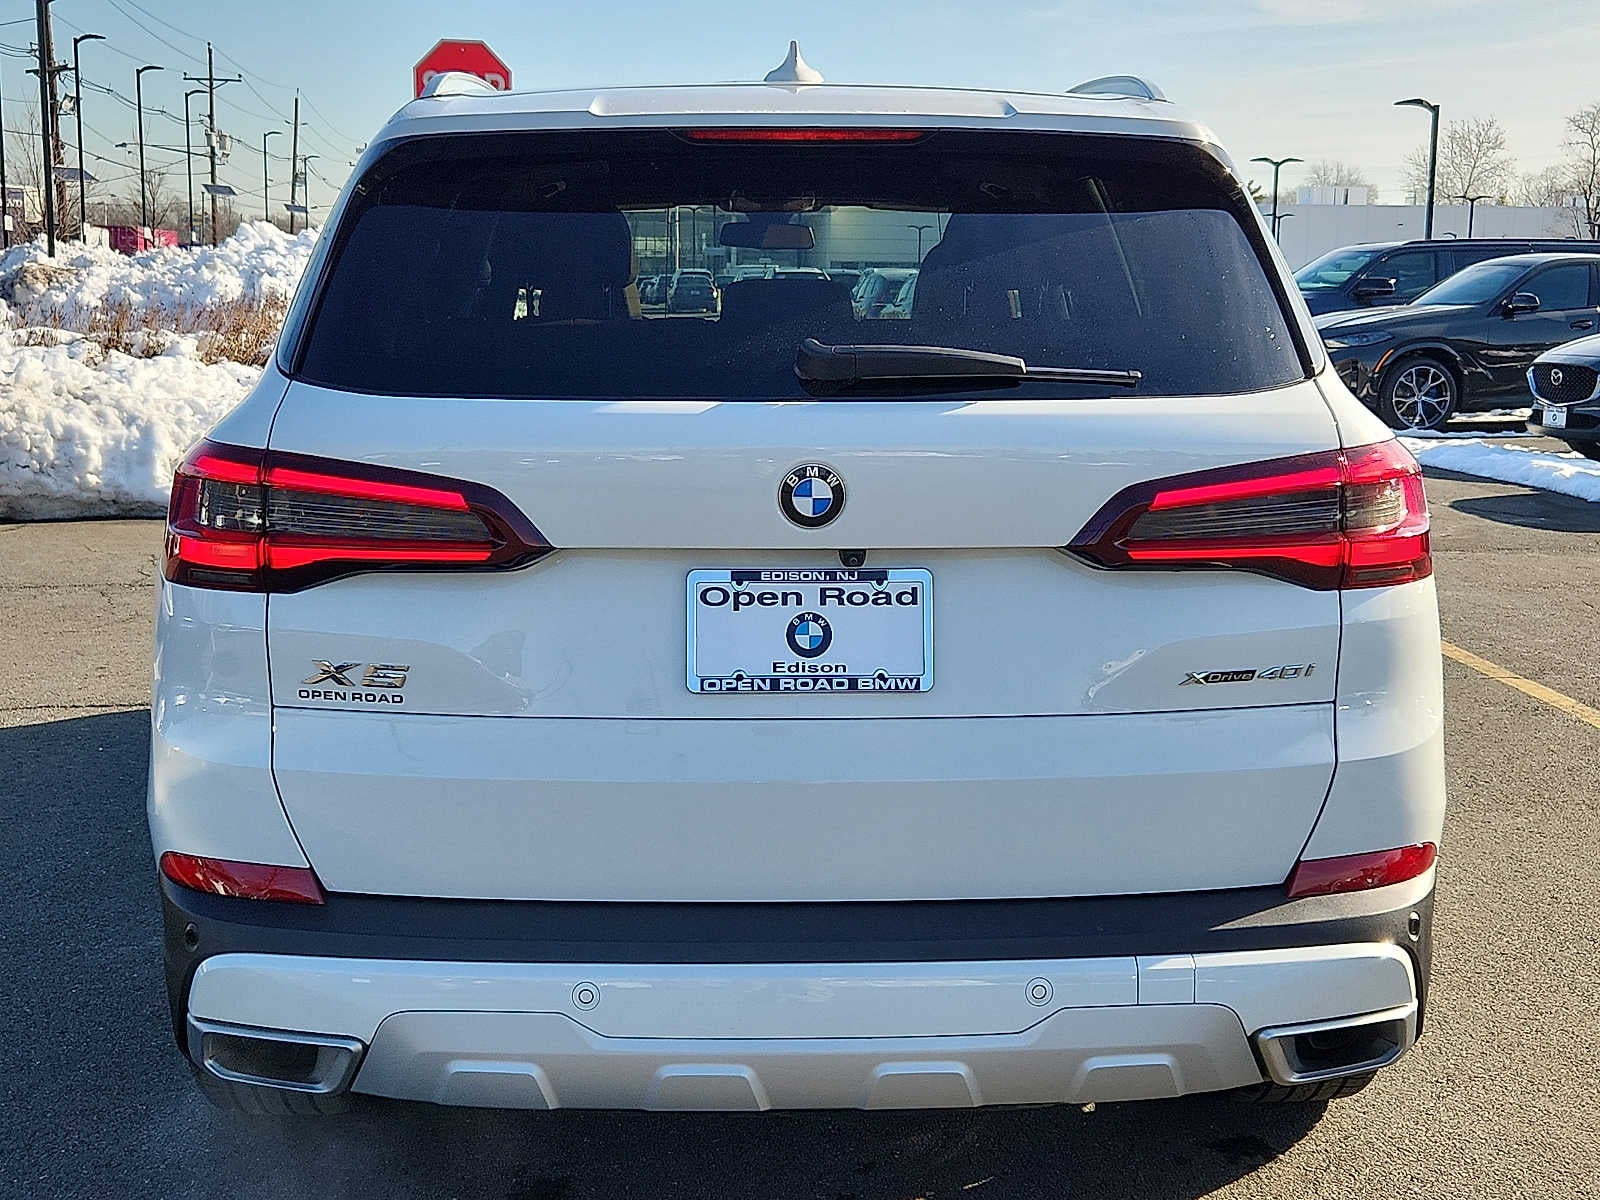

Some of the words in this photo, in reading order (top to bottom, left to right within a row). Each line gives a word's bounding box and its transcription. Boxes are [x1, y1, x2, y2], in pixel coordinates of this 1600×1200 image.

[786, 466, 840, 488] BMW
[760, 571, 830, 582] EDISON,
[836, 571, 858, 581] NJ
[699, 586, 803, 612] Open
[819, 586, 918, 607] Road
[792, 613, 828, 627] BMW
[301, 659, 410, 688] X5
[772, 661, 847, 674] Edison
[703, 678, 771, 691] OPEN
[779, 678, 849, 691] ROAD
[857, 678, 918, 691] BMW
[298, 689, 347, 701] OPEN
[351, 692, 404, 704] ROAD
